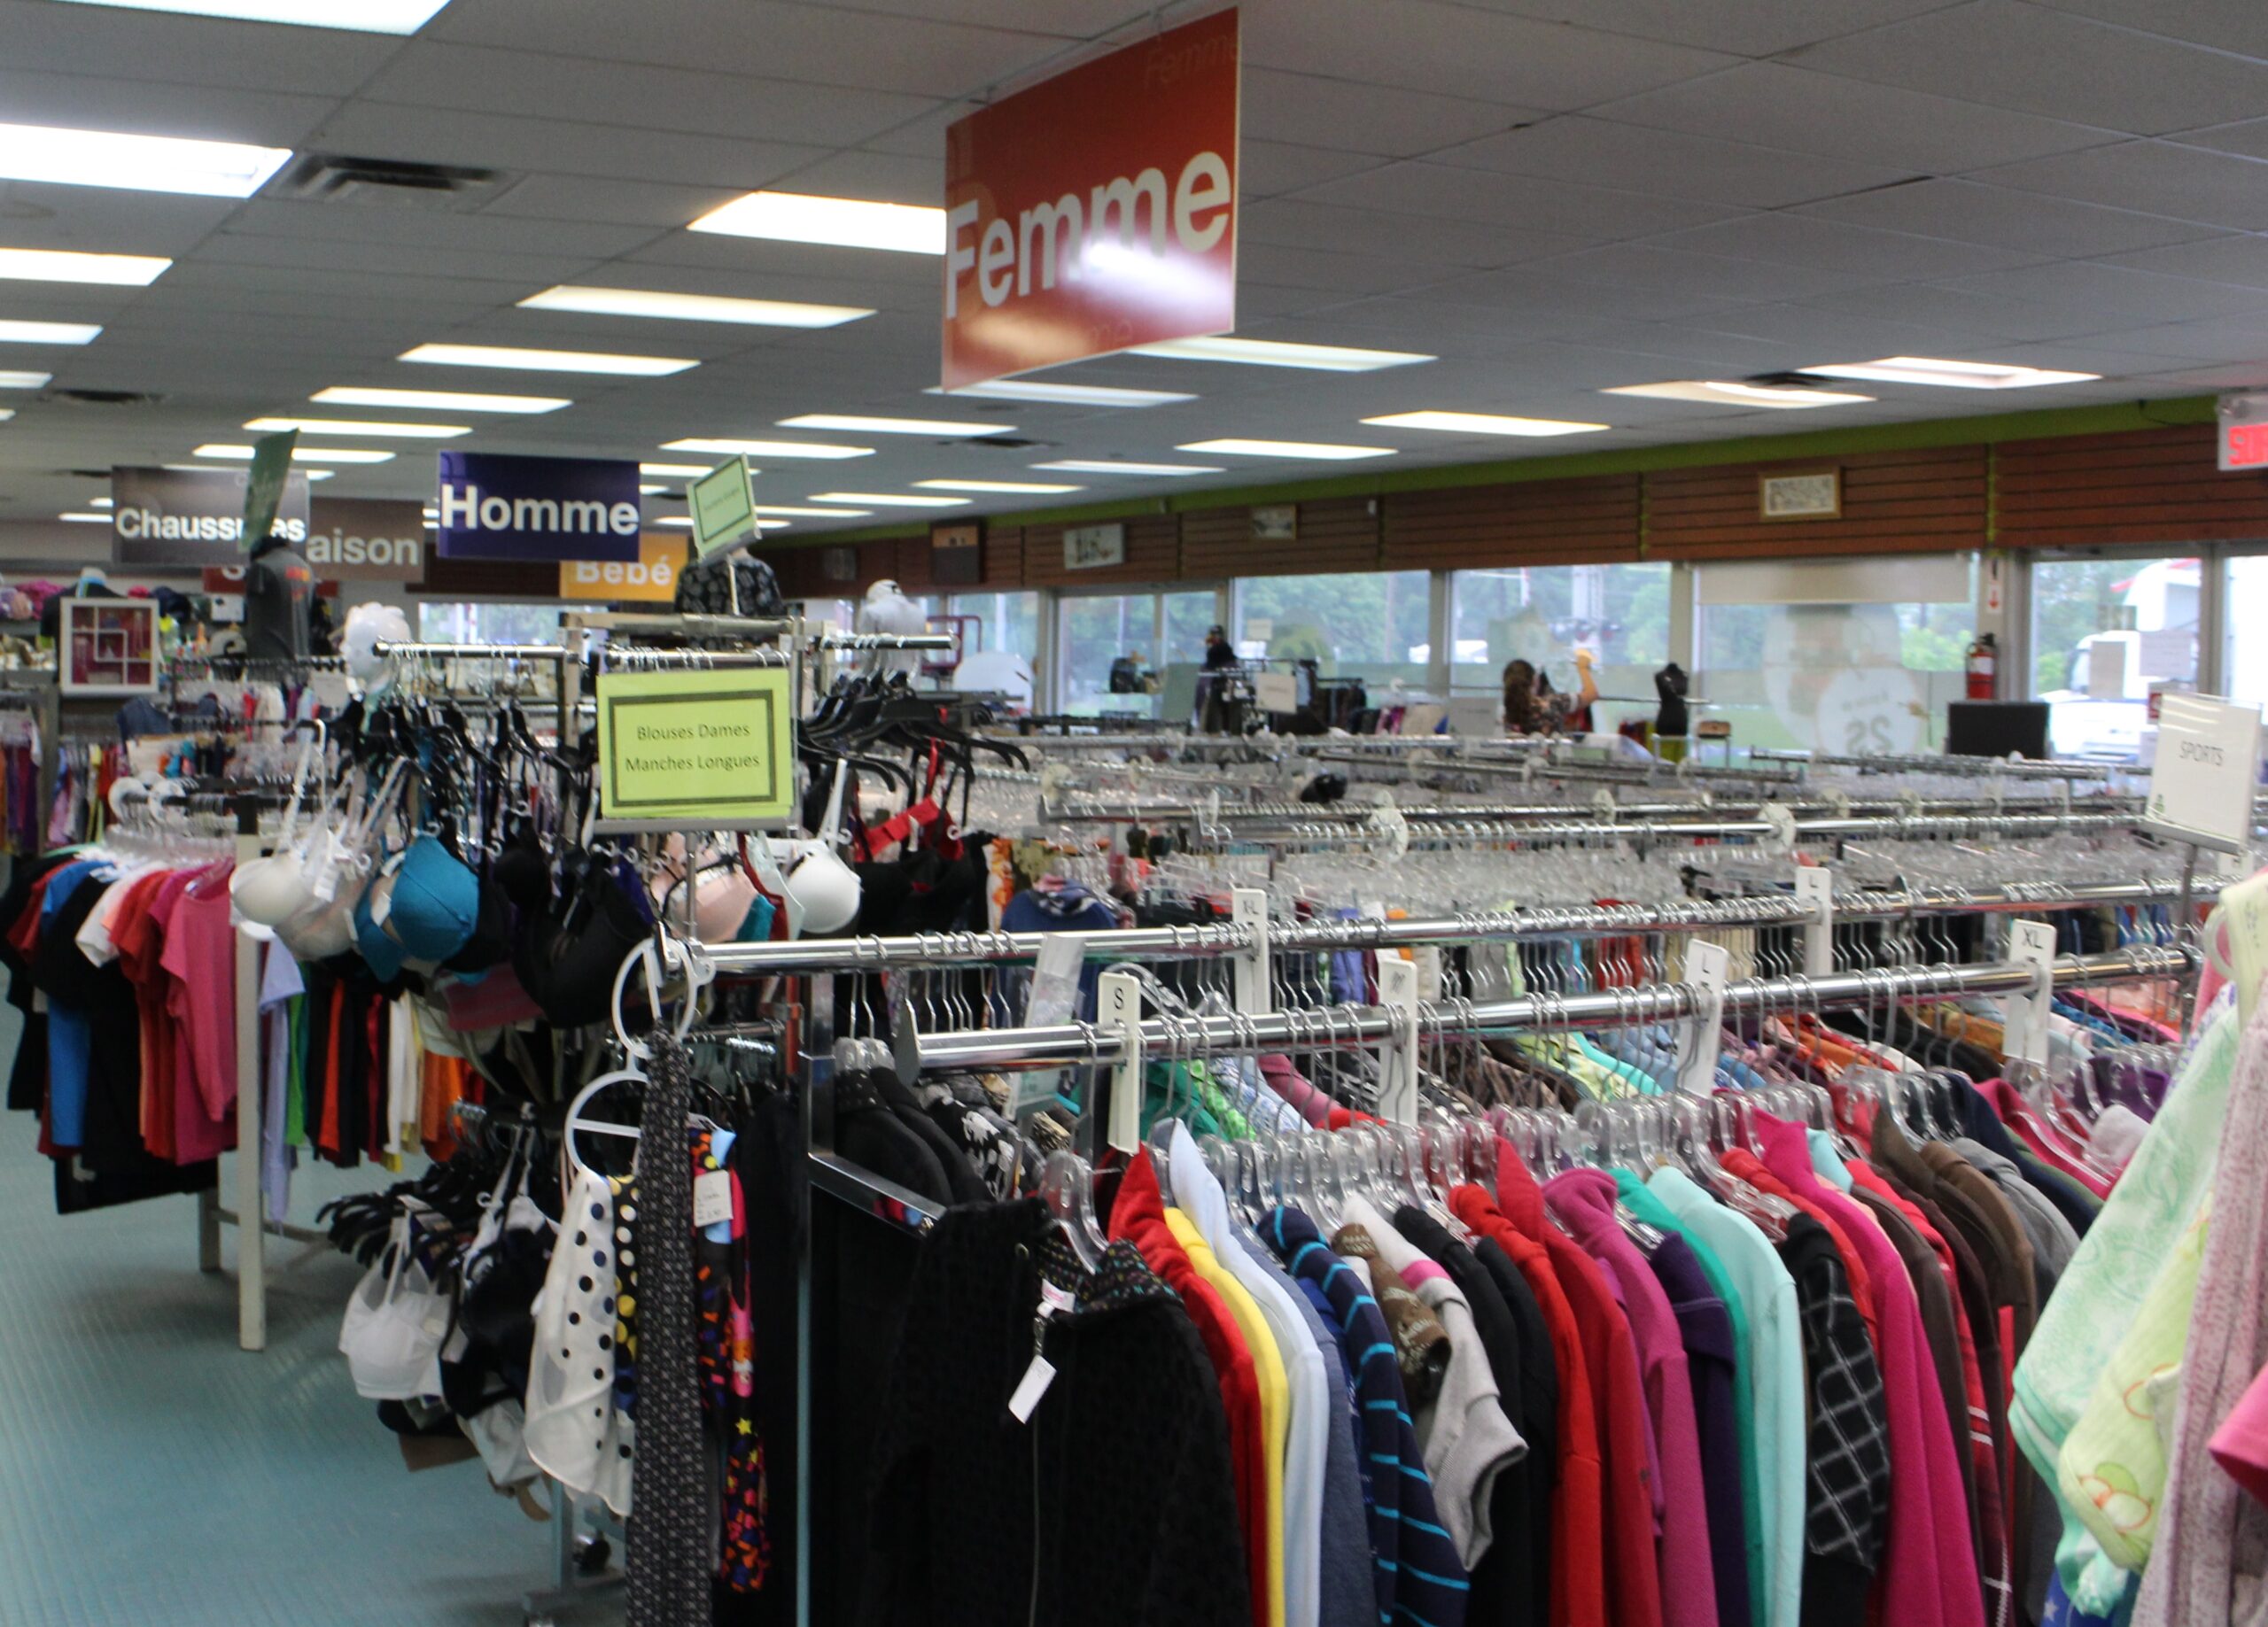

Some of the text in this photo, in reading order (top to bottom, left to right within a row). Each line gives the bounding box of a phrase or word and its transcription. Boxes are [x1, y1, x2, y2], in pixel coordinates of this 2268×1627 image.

[945, 151, 1231, 320] Femme
[441, 483, 640, 535] Homme
[115, 507, 307, 542] Chausses
[307, 528, 419, 565] aison
[637, 723, 750, 741] Blouses Dames
[625, 755, 759, 772] Manches Longues
[2179, 740, 2225, 767] SPORTS
[1809, 874, 1819, 888] L
[2021, 927, 2043, 949] XL
[1702, 952, 1711, 974] L
[1113, 987, 1124, 1011] S
